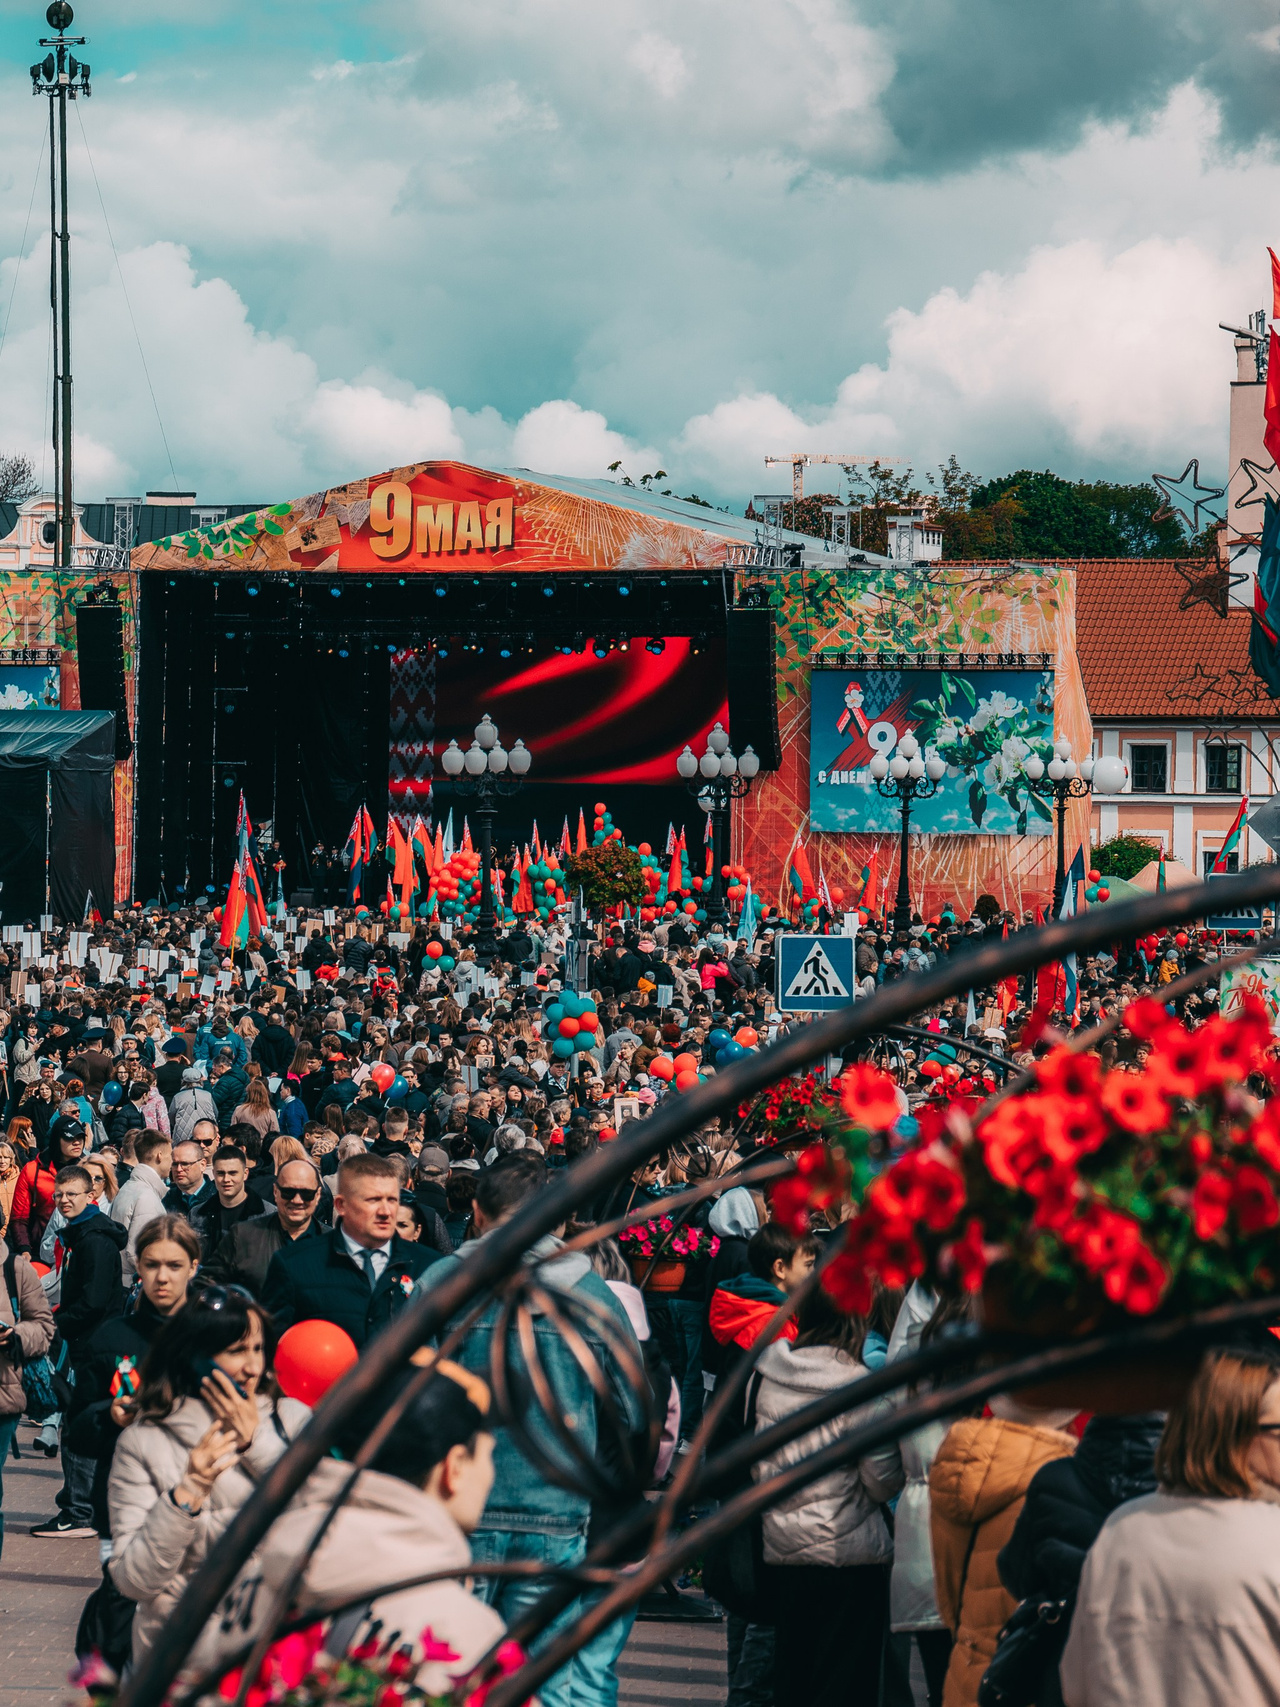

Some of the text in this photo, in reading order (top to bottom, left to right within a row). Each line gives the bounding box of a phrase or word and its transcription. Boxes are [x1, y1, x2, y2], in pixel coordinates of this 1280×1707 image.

[369, 481, 514, 558] 9 МАЯ
[818, 770, 827, 784] С
[830, 770, 867, 785] ДНЕМ
